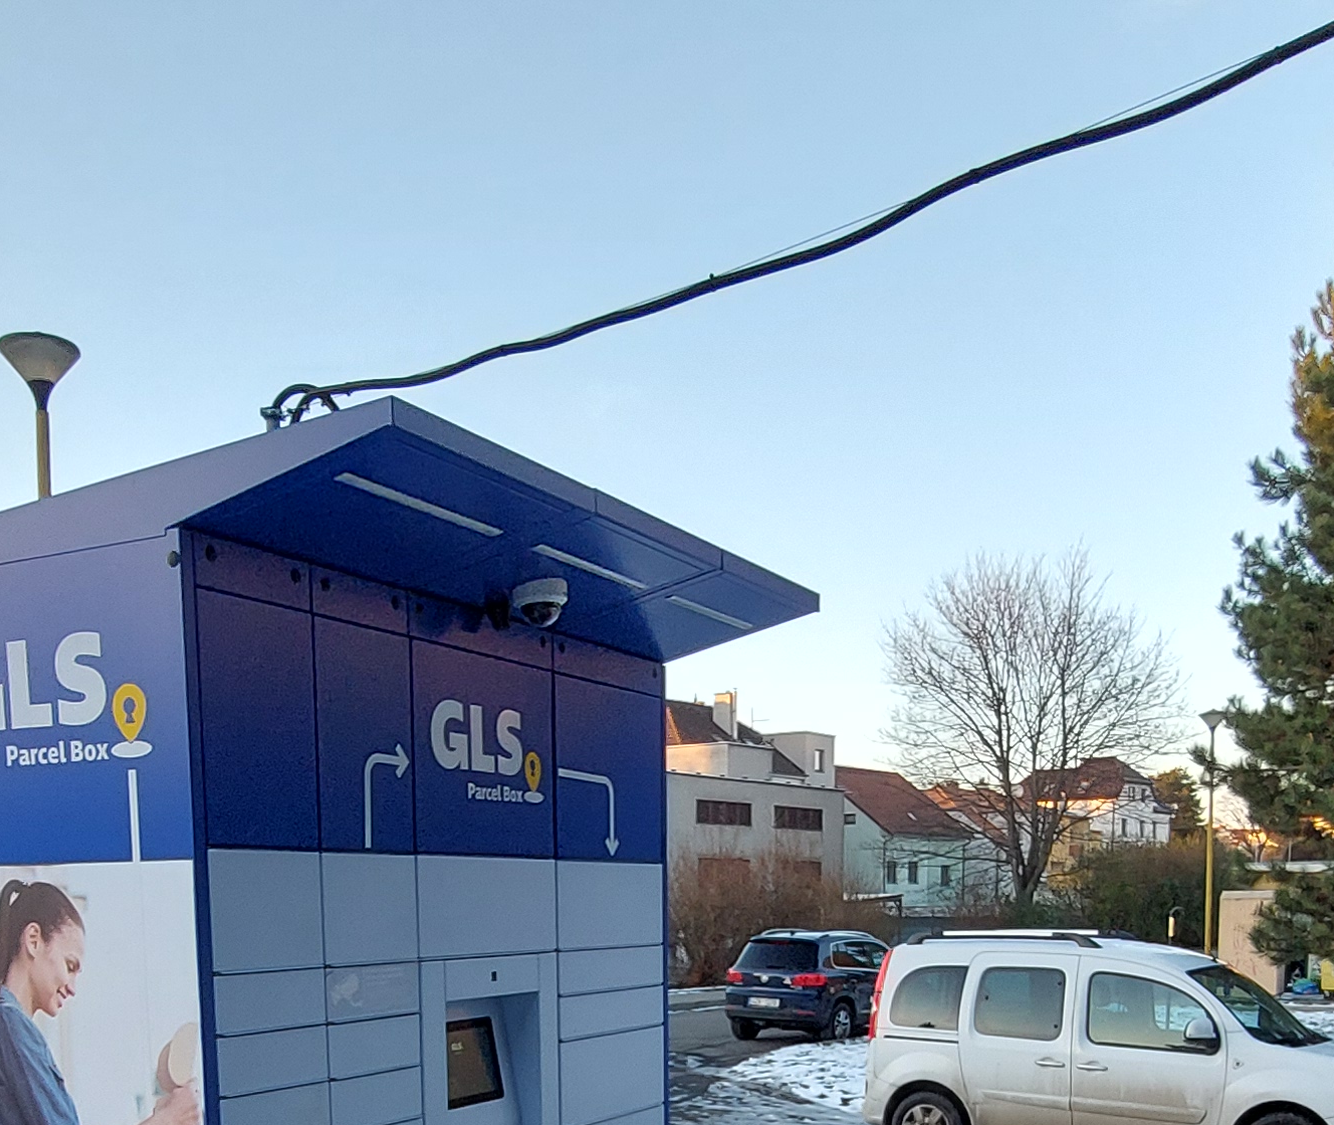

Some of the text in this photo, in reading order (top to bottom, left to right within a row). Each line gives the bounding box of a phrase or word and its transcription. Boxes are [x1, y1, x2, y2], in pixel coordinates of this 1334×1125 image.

[431, 700, 524, 776] GLS
[5, 740, 110, 767] Parcel Box
[468, 783, 524, 803] Parcel Box
